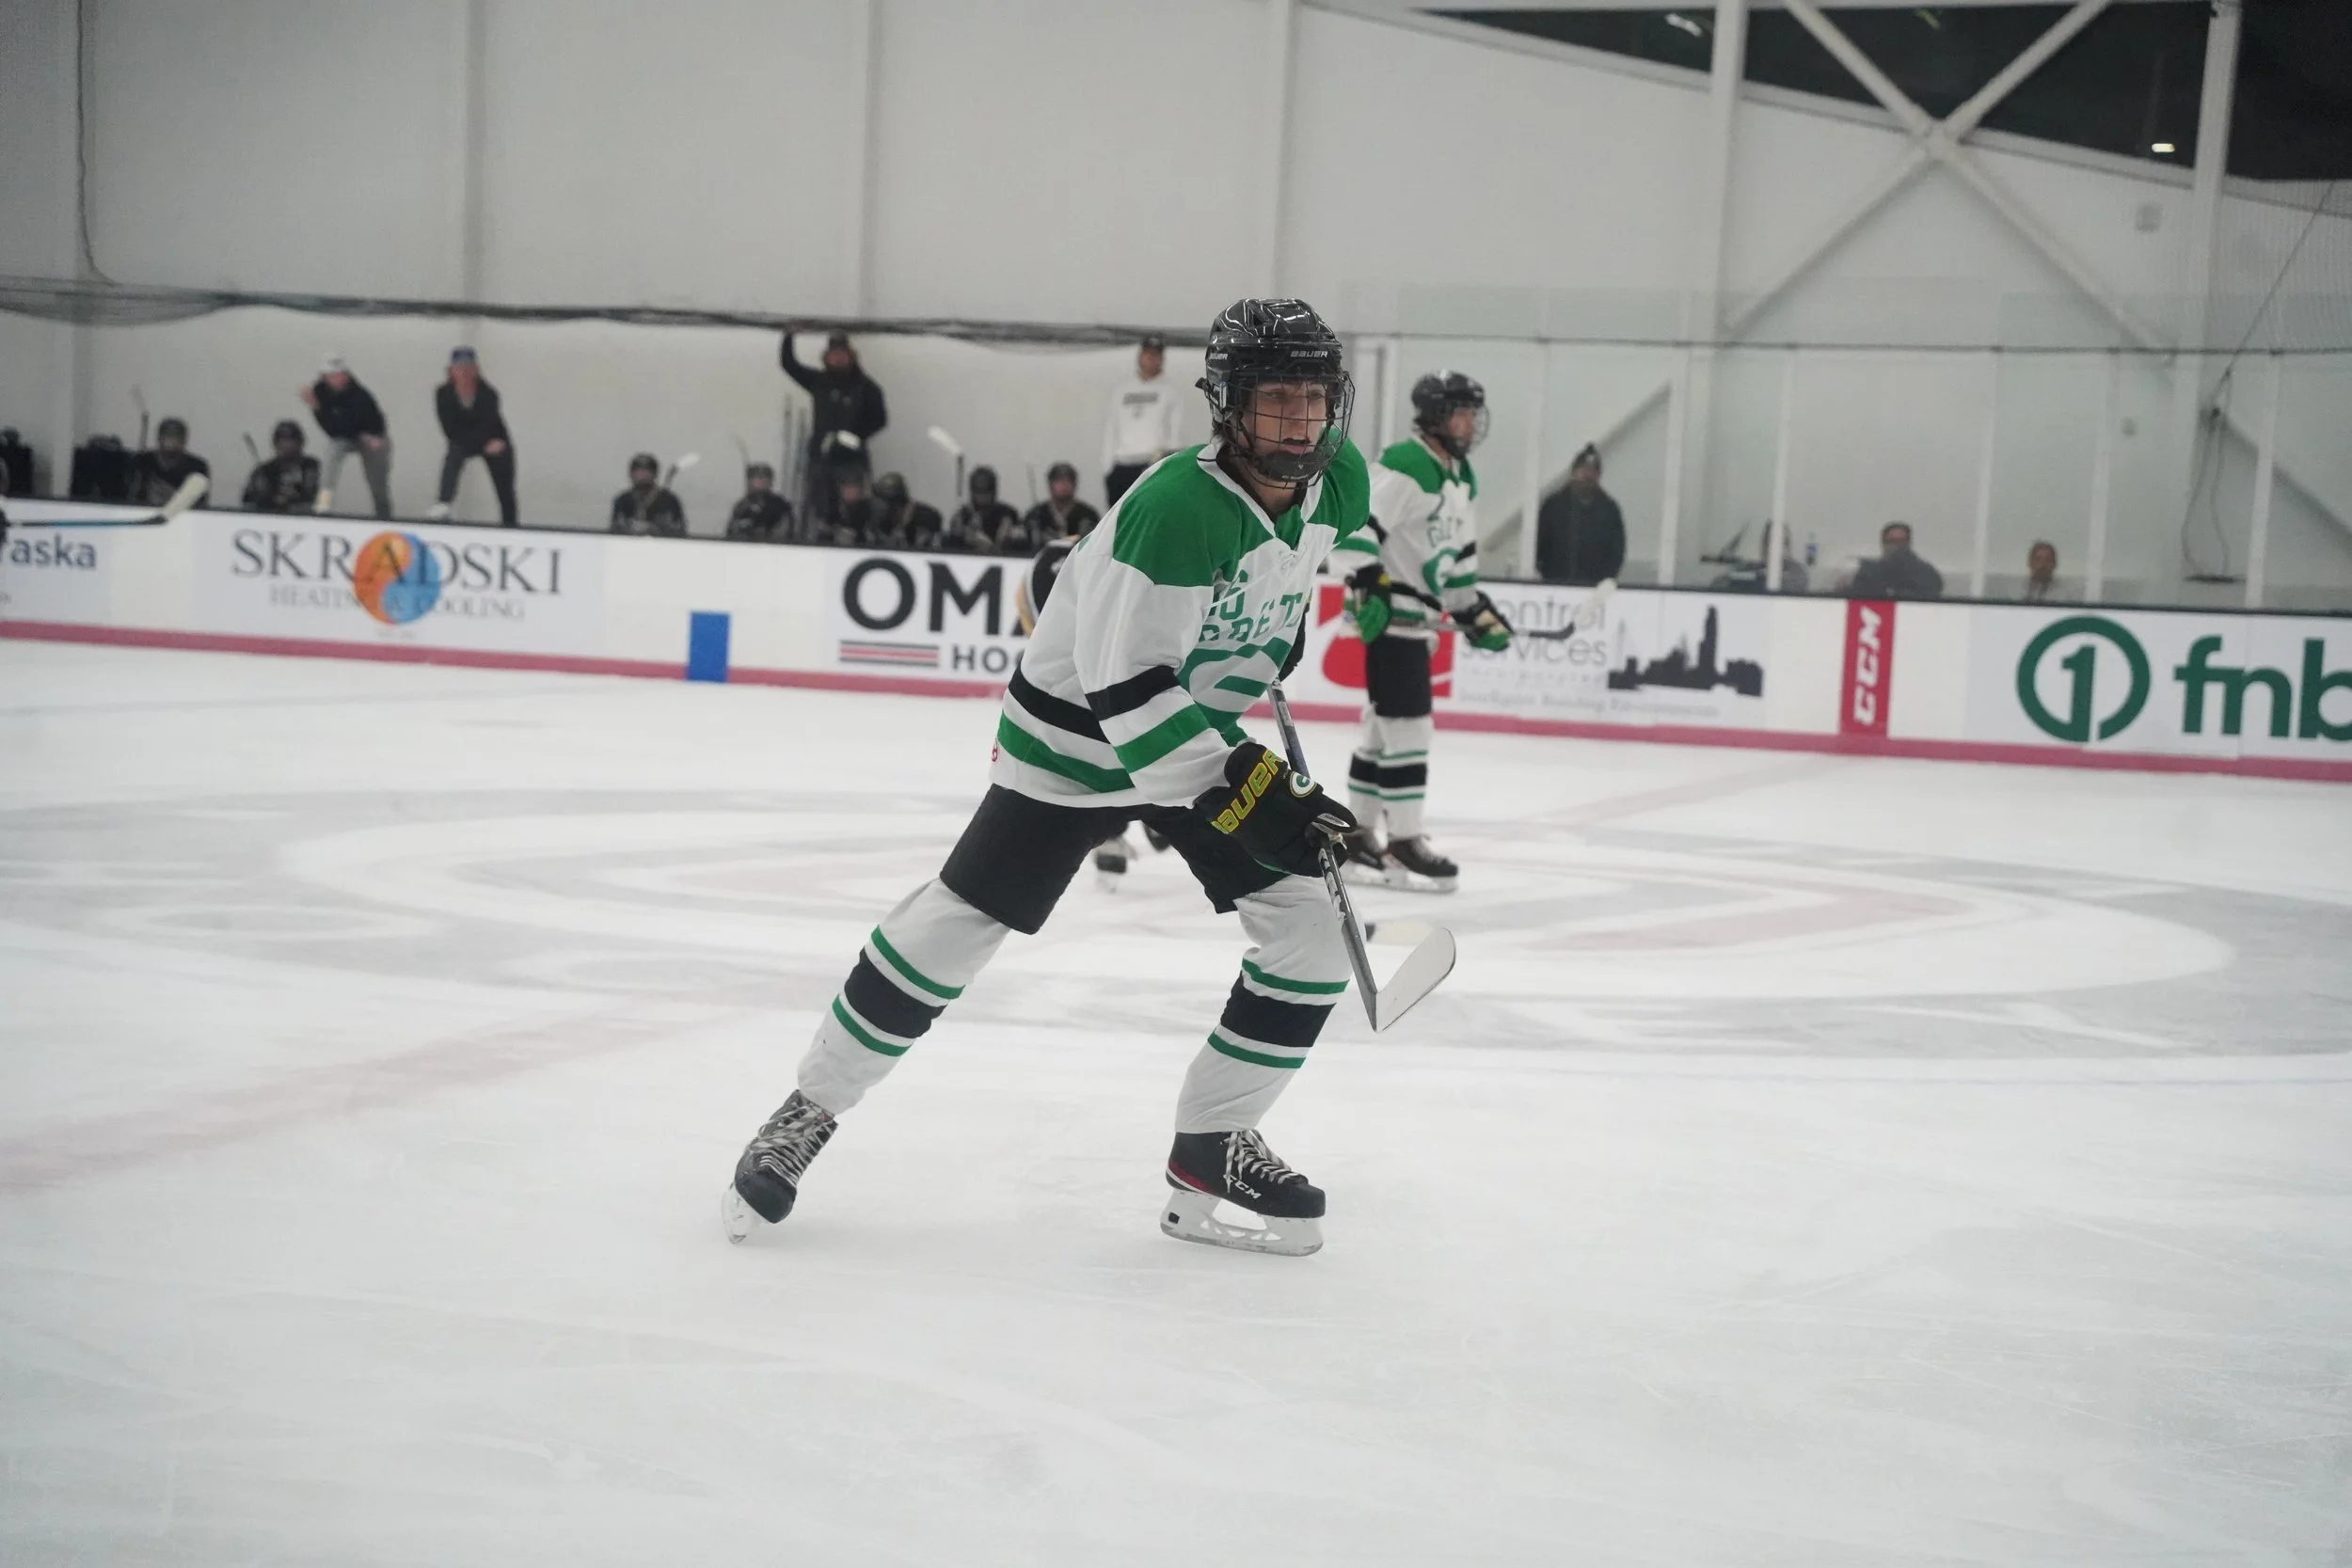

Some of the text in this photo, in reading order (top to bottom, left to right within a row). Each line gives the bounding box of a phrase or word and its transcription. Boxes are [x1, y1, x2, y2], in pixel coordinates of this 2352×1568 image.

[843, 557, 1030, 637] OM
[952, 643, 1025, 675] HO
[1851, 606, 1882, 726] CCM
[1211, 749, 1284, 834] AUER
